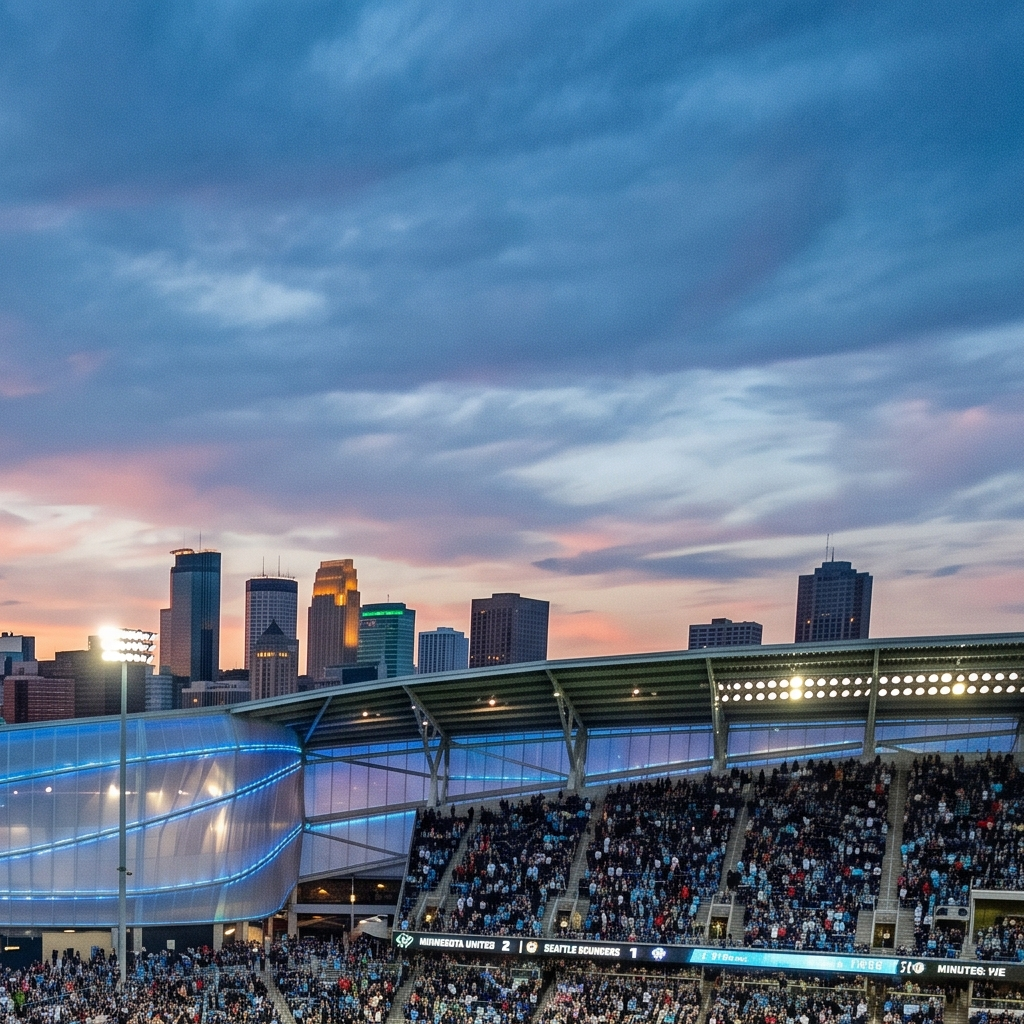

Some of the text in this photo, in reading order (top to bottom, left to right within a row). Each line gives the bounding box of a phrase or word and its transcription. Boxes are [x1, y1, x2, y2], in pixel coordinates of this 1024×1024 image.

[501, 940, 510, 952] 2
[544, 943, 577, 954] SEATTLE
[629, 947, 637, 958] 1
